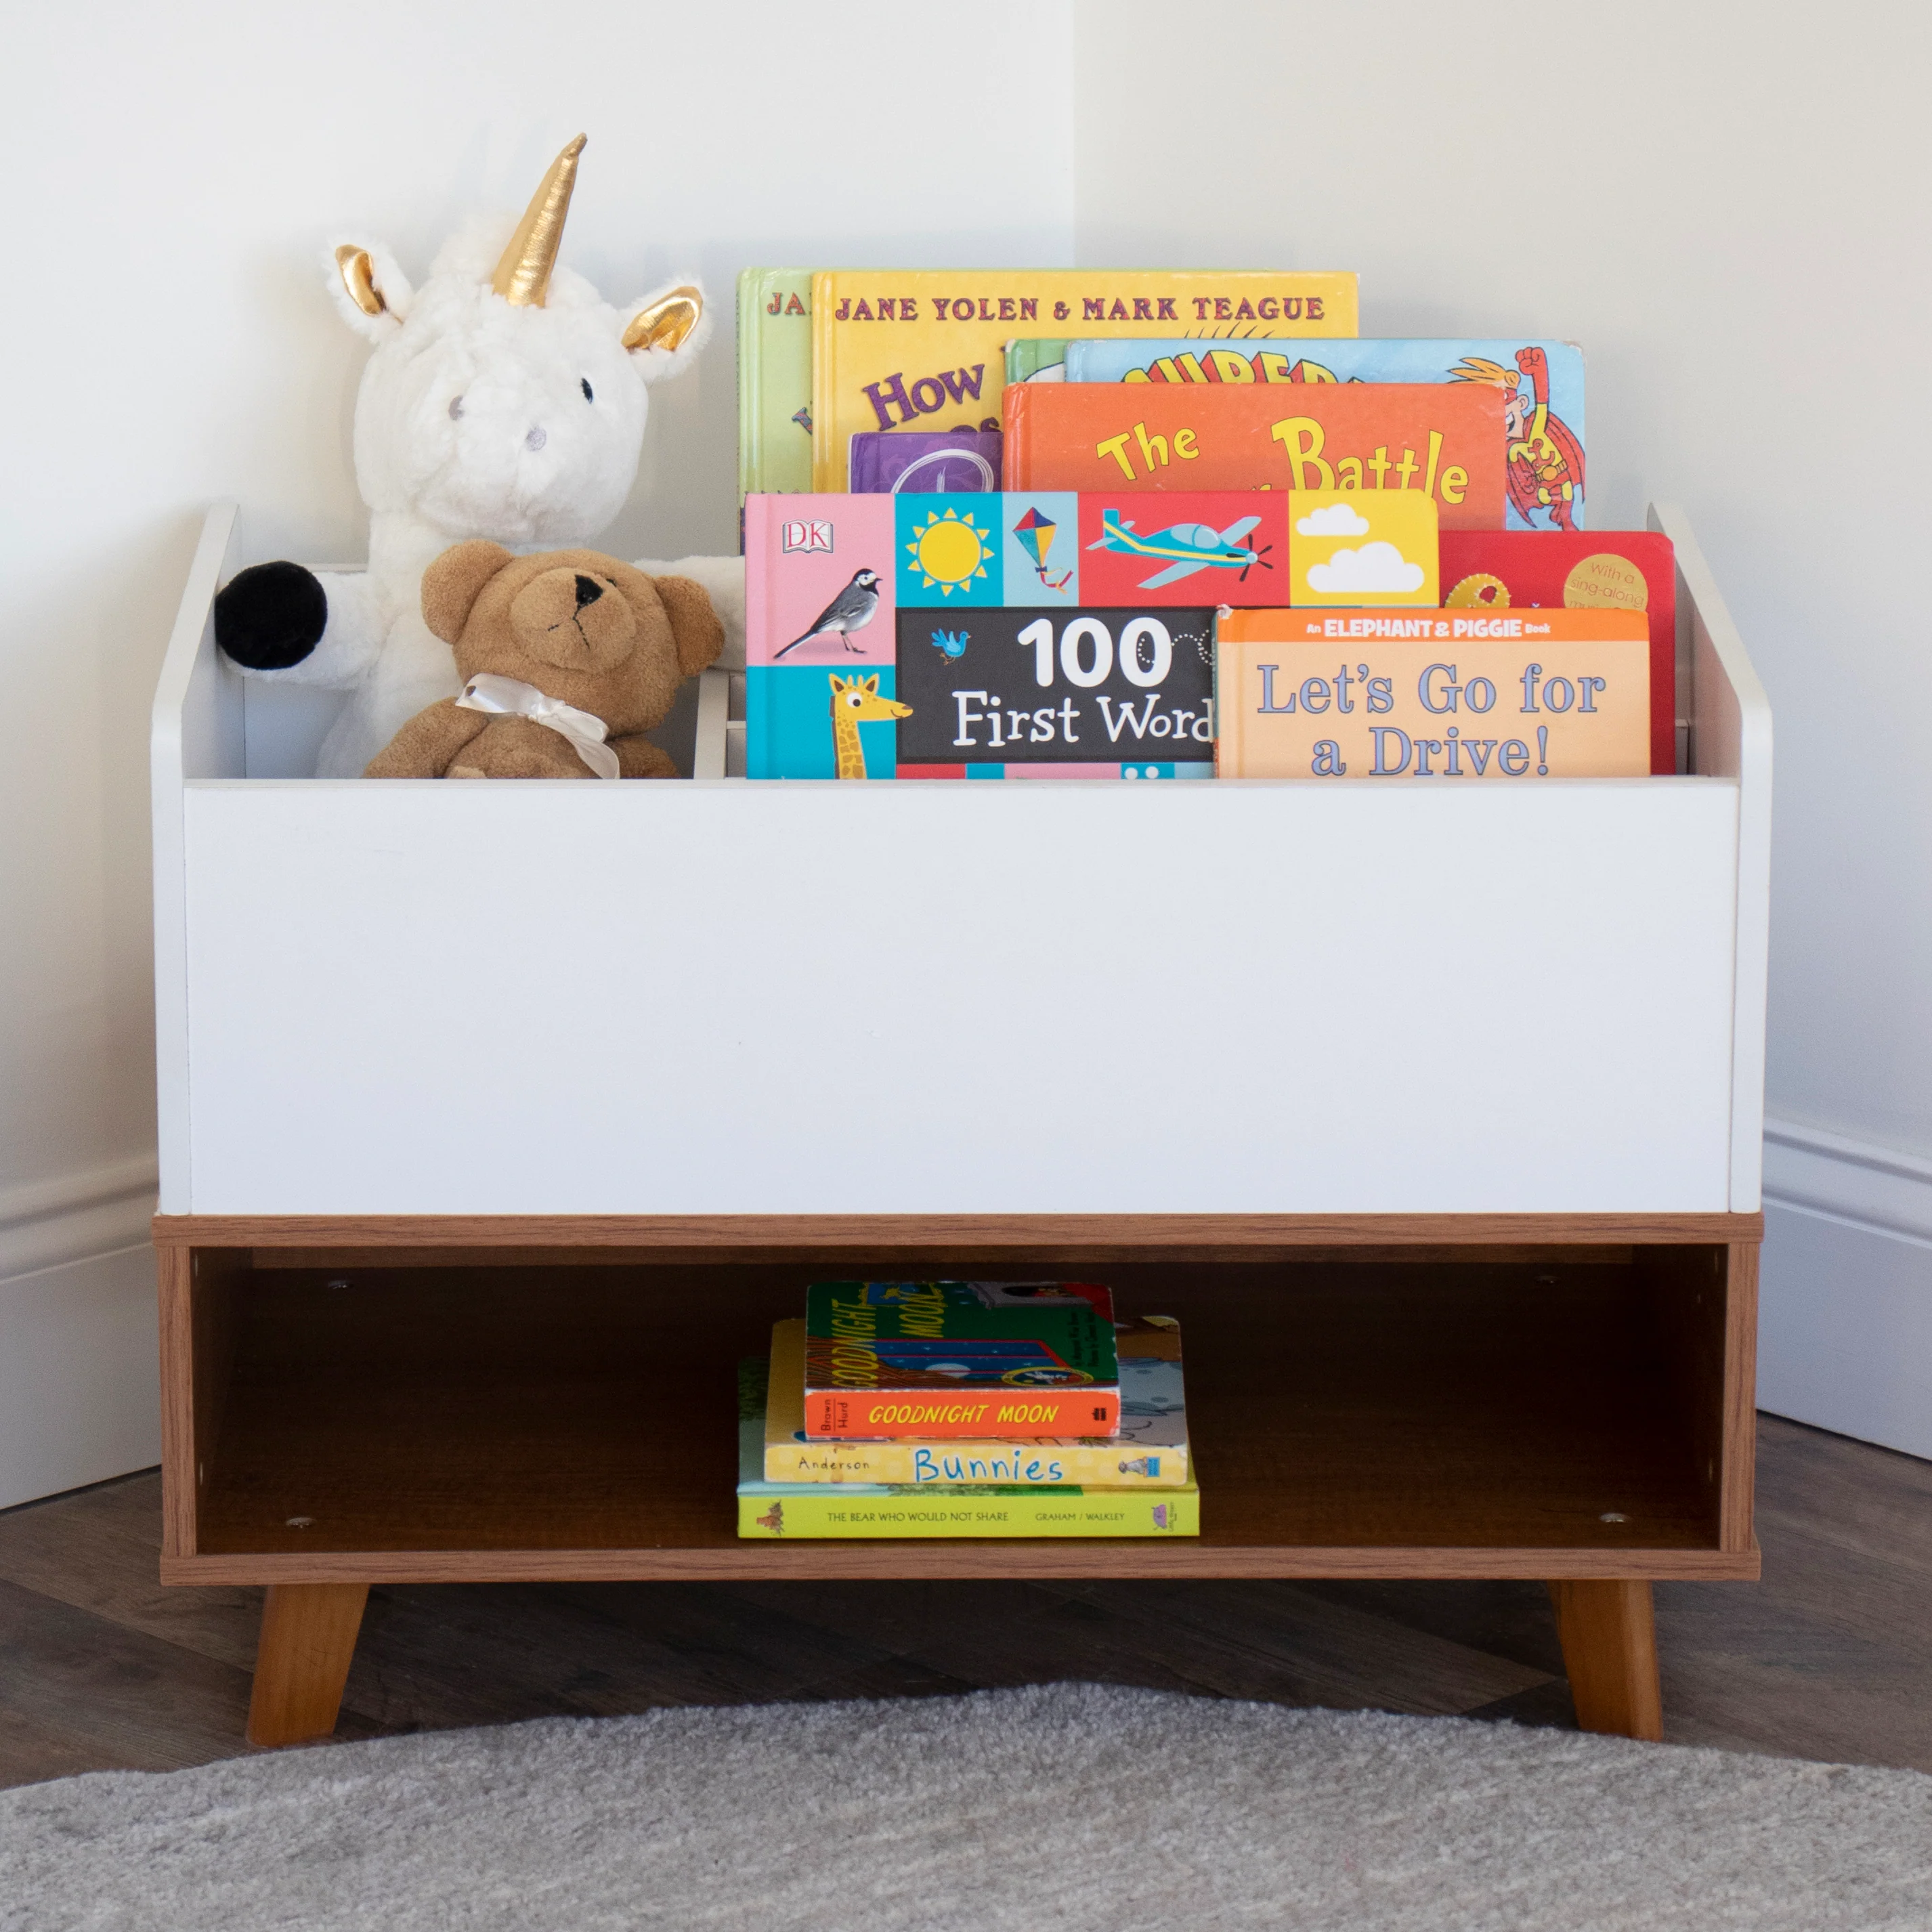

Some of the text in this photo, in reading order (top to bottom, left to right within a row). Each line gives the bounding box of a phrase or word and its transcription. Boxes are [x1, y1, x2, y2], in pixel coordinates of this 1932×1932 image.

[767, 292, 812, 316] JA
[835, 297, 1325, 322] JANE YOLEN & MARK TEAGUE
[1096, 415, 1469, 505] The Battle
[787, 521, 830, 548] DK
[1570, 576, 1644, 608] sing-along
[1625, 574, 1635, 584] a
[1306, 618, 1551, 637] An ELEPHANT & PIGGIE Book
[1018, 617, 1173, 688] 100
[1256, 663, 1607, 714] Let's Go for
[952, 689, 1080, 748] First
[1311, 725, 1549, 776] a Drive!
[831, 1297, 880, 1388] GOODNIGHT
[821, 1399, 832, 1432] Brown
[838, 1402, 849, 1429] Hurd
[869, 1404, 1060, 1424] GOODNIGHT MOON
[798, 1448, 1063, 1482] Anderson Bunnies
[828, 1512, 1009, 1522] THE BEAR WHO WOULD NOT SHARE
[1035, 1513, 1076, 1521] GRAHAM
[1086, 1513, 1125, 1521] WALKLEY
